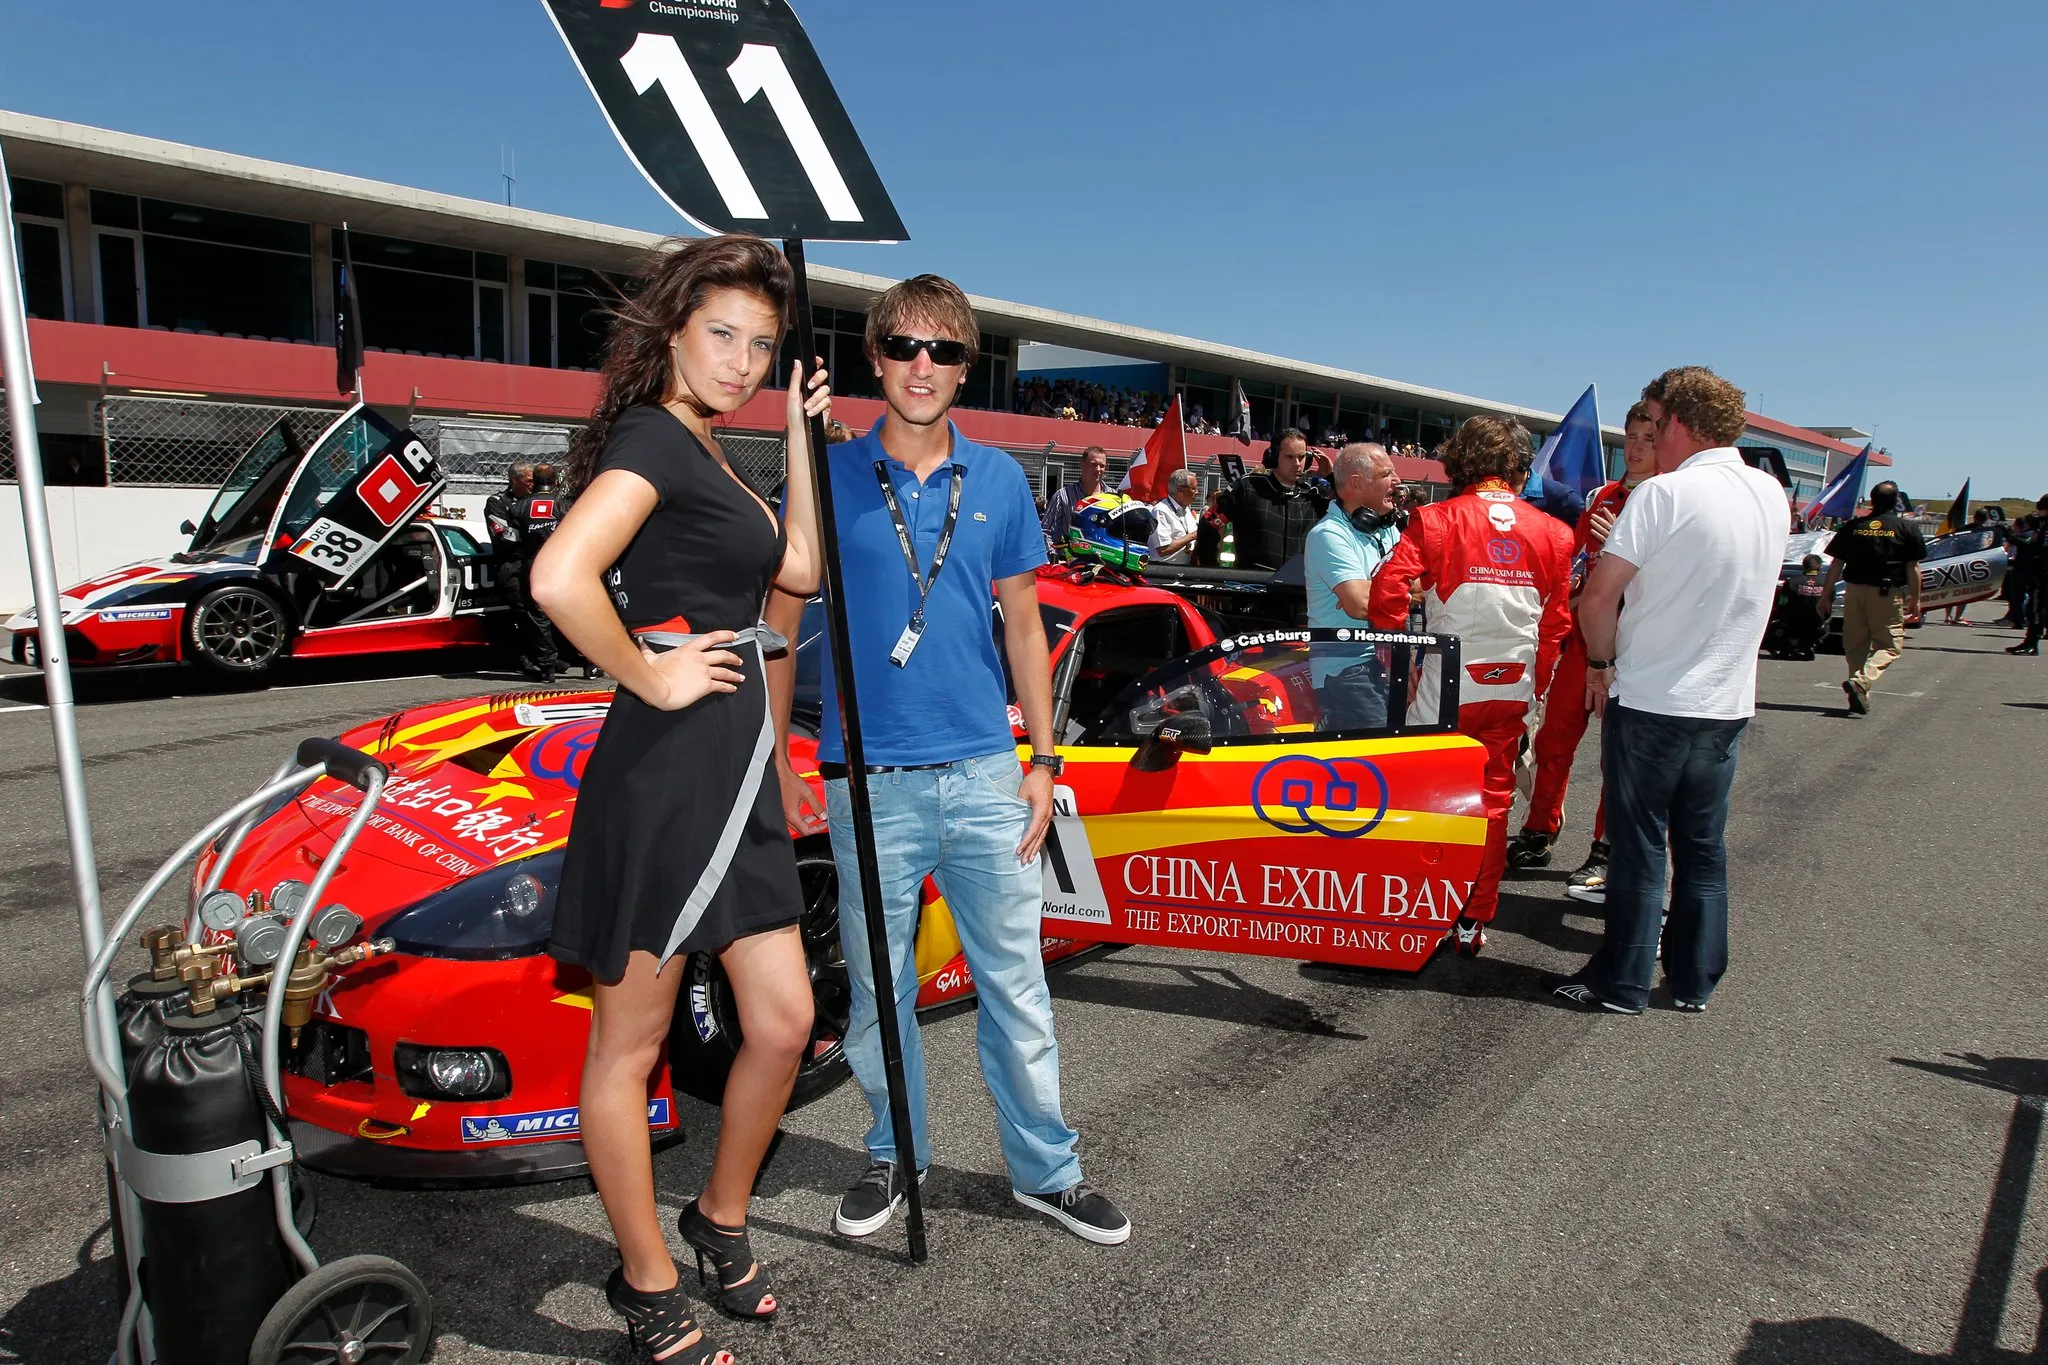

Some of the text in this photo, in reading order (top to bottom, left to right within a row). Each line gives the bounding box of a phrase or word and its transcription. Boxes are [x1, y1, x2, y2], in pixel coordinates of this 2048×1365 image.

[649, 1, 739, 24] Championship
[619, 32, 864, 222] 11
[309, 522, 331, 541] DEU
[1853, 529, 1896, 537] PROSEGUR
[312, 530, 362, 567] 38
[1469, 566, 1495, 575] CHINA
[1920, 558, 1990, 591] EXIS
[117, 610, 168, 619] MICHELIN
[191, 606, 206, 643] MICHELIN
[1237, 630, 1311, 647] Catsburg
[301, 794, 324, 809] THE
[317, 799, 393, 829] EXPORT-IORT
[383, 819, 425, 848] BANK
[418, 843, 444, 858] OF
[1123, 854, 1477, 922] CHINA EXIM BAN
[1042, 901, 1105, 918] World.com
[1124, 908, 1161, 931] THE
[1166, 912, 1324, 945] EXPORT-IMPORT
[1332, 927, 1392, 951] BANK
[1400, 933, 1428, 954] OF
[693, 950, 710, 1013] MICH
[515, 1104, 658, 1132] MICN
